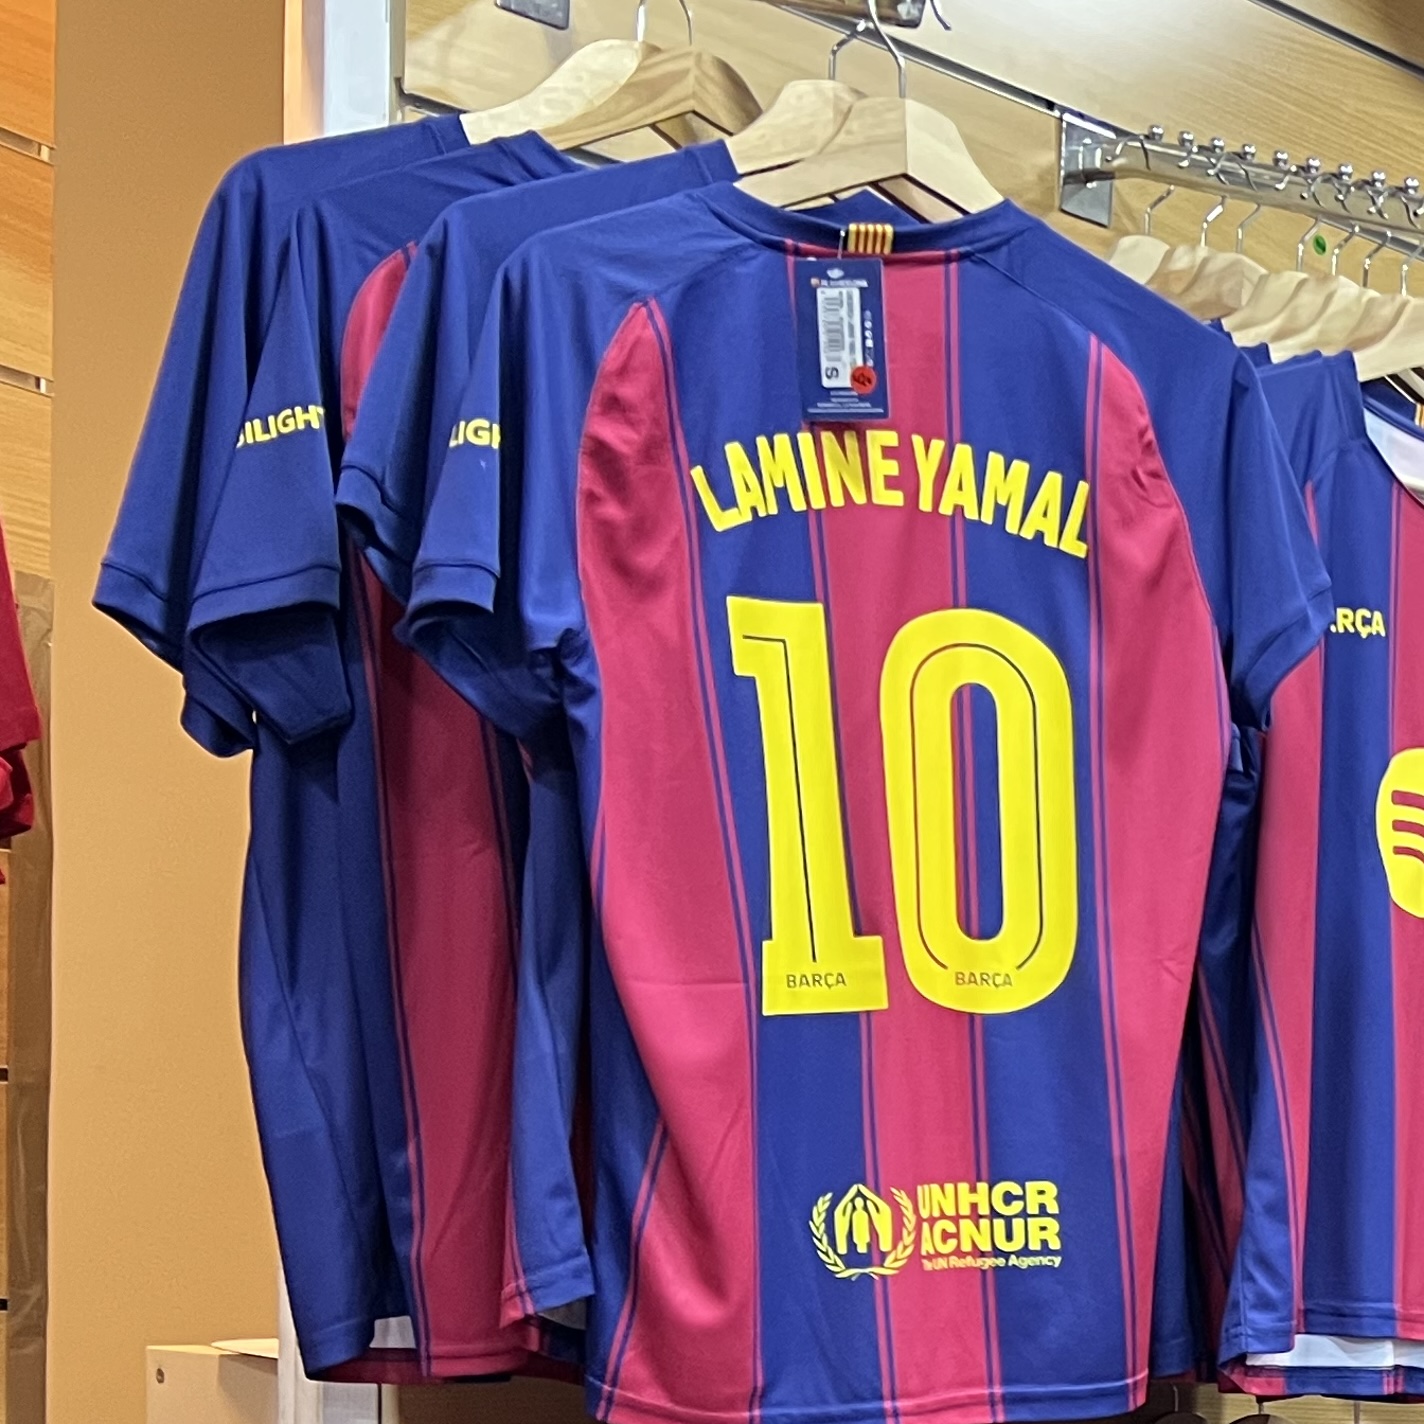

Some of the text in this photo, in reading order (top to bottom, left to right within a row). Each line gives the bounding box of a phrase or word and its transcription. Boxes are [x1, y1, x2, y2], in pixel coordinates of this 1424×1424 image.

[690, 430, 1089, 559] LAMINE YAMAL
[727, 595, 1078, 1016] 10
[786, 972, 847, 989] BARÇA
[954, 971, 1013, 989] BARÇA
[917, 1180, 1060, 1219] UNHCR
[920, 1216, 1062, 1256] ACNUR
[1008, 1253, 1062, 1270] Agency
